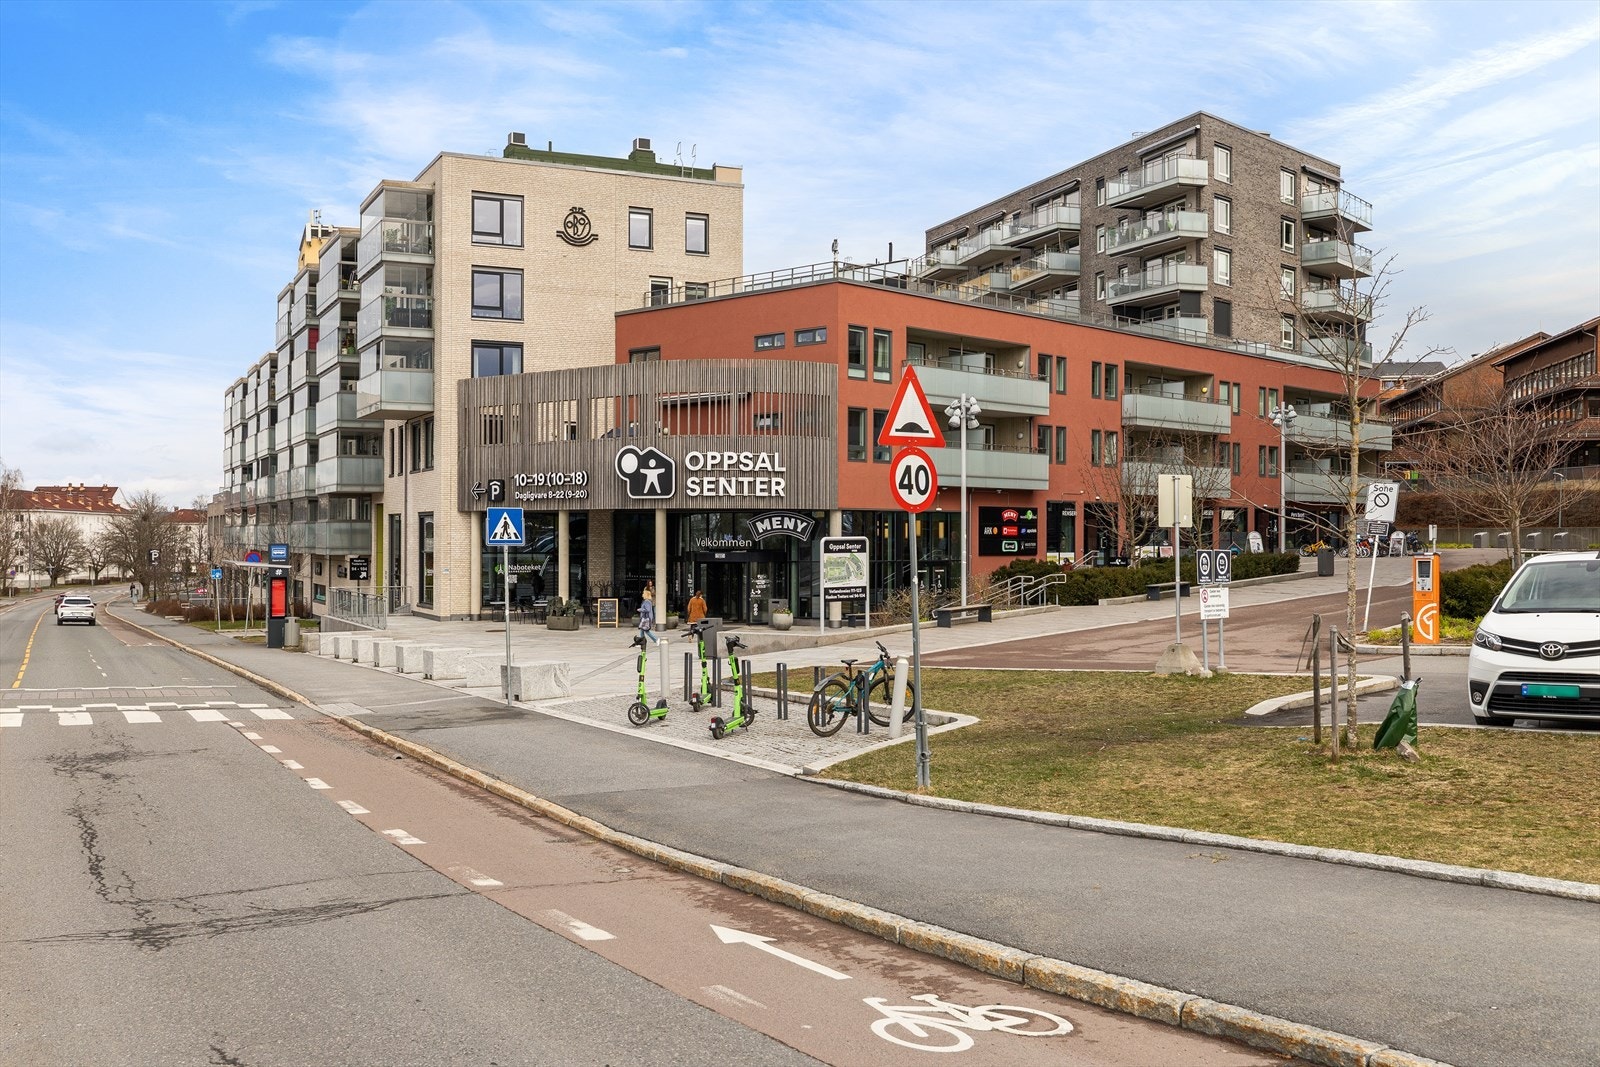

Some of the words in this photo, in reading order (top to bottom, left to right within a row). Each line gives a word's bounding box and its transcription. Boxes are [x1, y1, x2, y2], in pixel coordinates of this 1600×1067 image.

[685, 451, 786, 472] OPPSAL
[898, 464, 930, 496] 40
[686, 477, 785, 497] SENTER
[1374, 484, 1393, 492] Sone
[515, 491, 547, 501] Dagligvare
[755, 516, 808, 533] MENY
[695, 537, 753, 547] Velkommen
[828, 543, 846, 552] Oppsal
